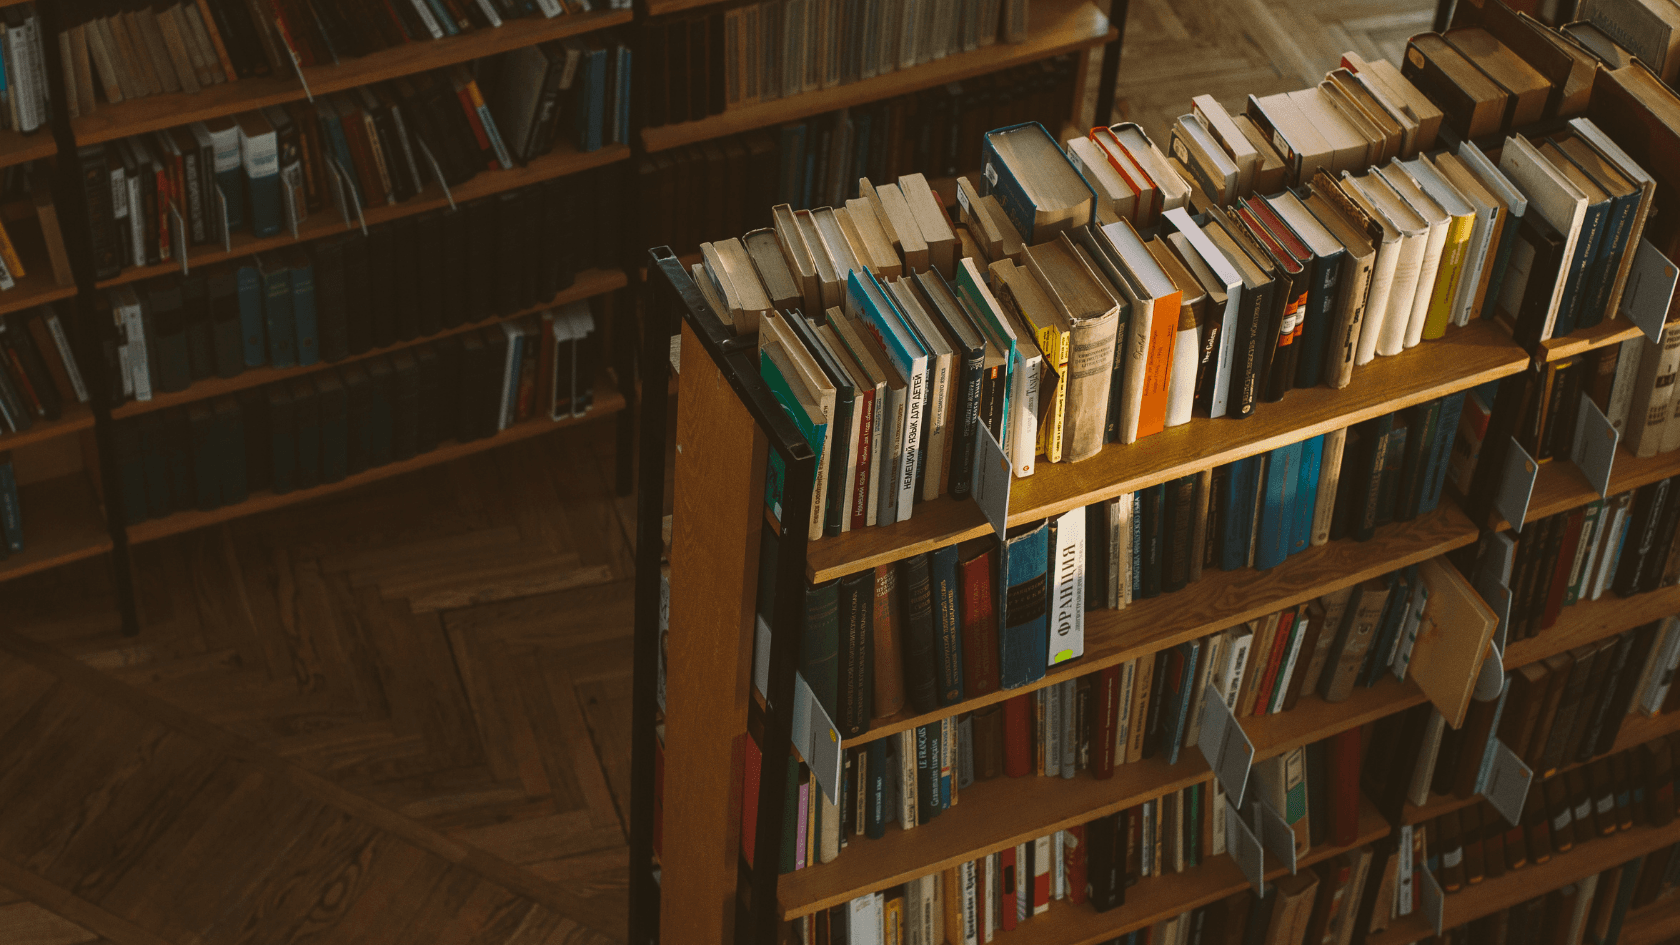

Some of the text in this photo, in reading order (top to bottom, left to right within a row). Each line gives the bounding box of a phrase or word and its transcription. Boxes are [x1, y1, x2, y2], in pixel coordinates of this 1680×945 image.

[1202, 328, 1217, 363] Der Golem
[1027, 373, 1039, 396] TANJA
[904, 373, 922, 490] НЕМЕЦКИЙ ЯЗЫК ДЛЯ ДЕТЕЙ
[1058, 544, 1076, 636] ФРАНЦИЯ
[919, 727, 927, 769] LE FRANÇAIS
[931, 738, 939, 807] Grammaire française
